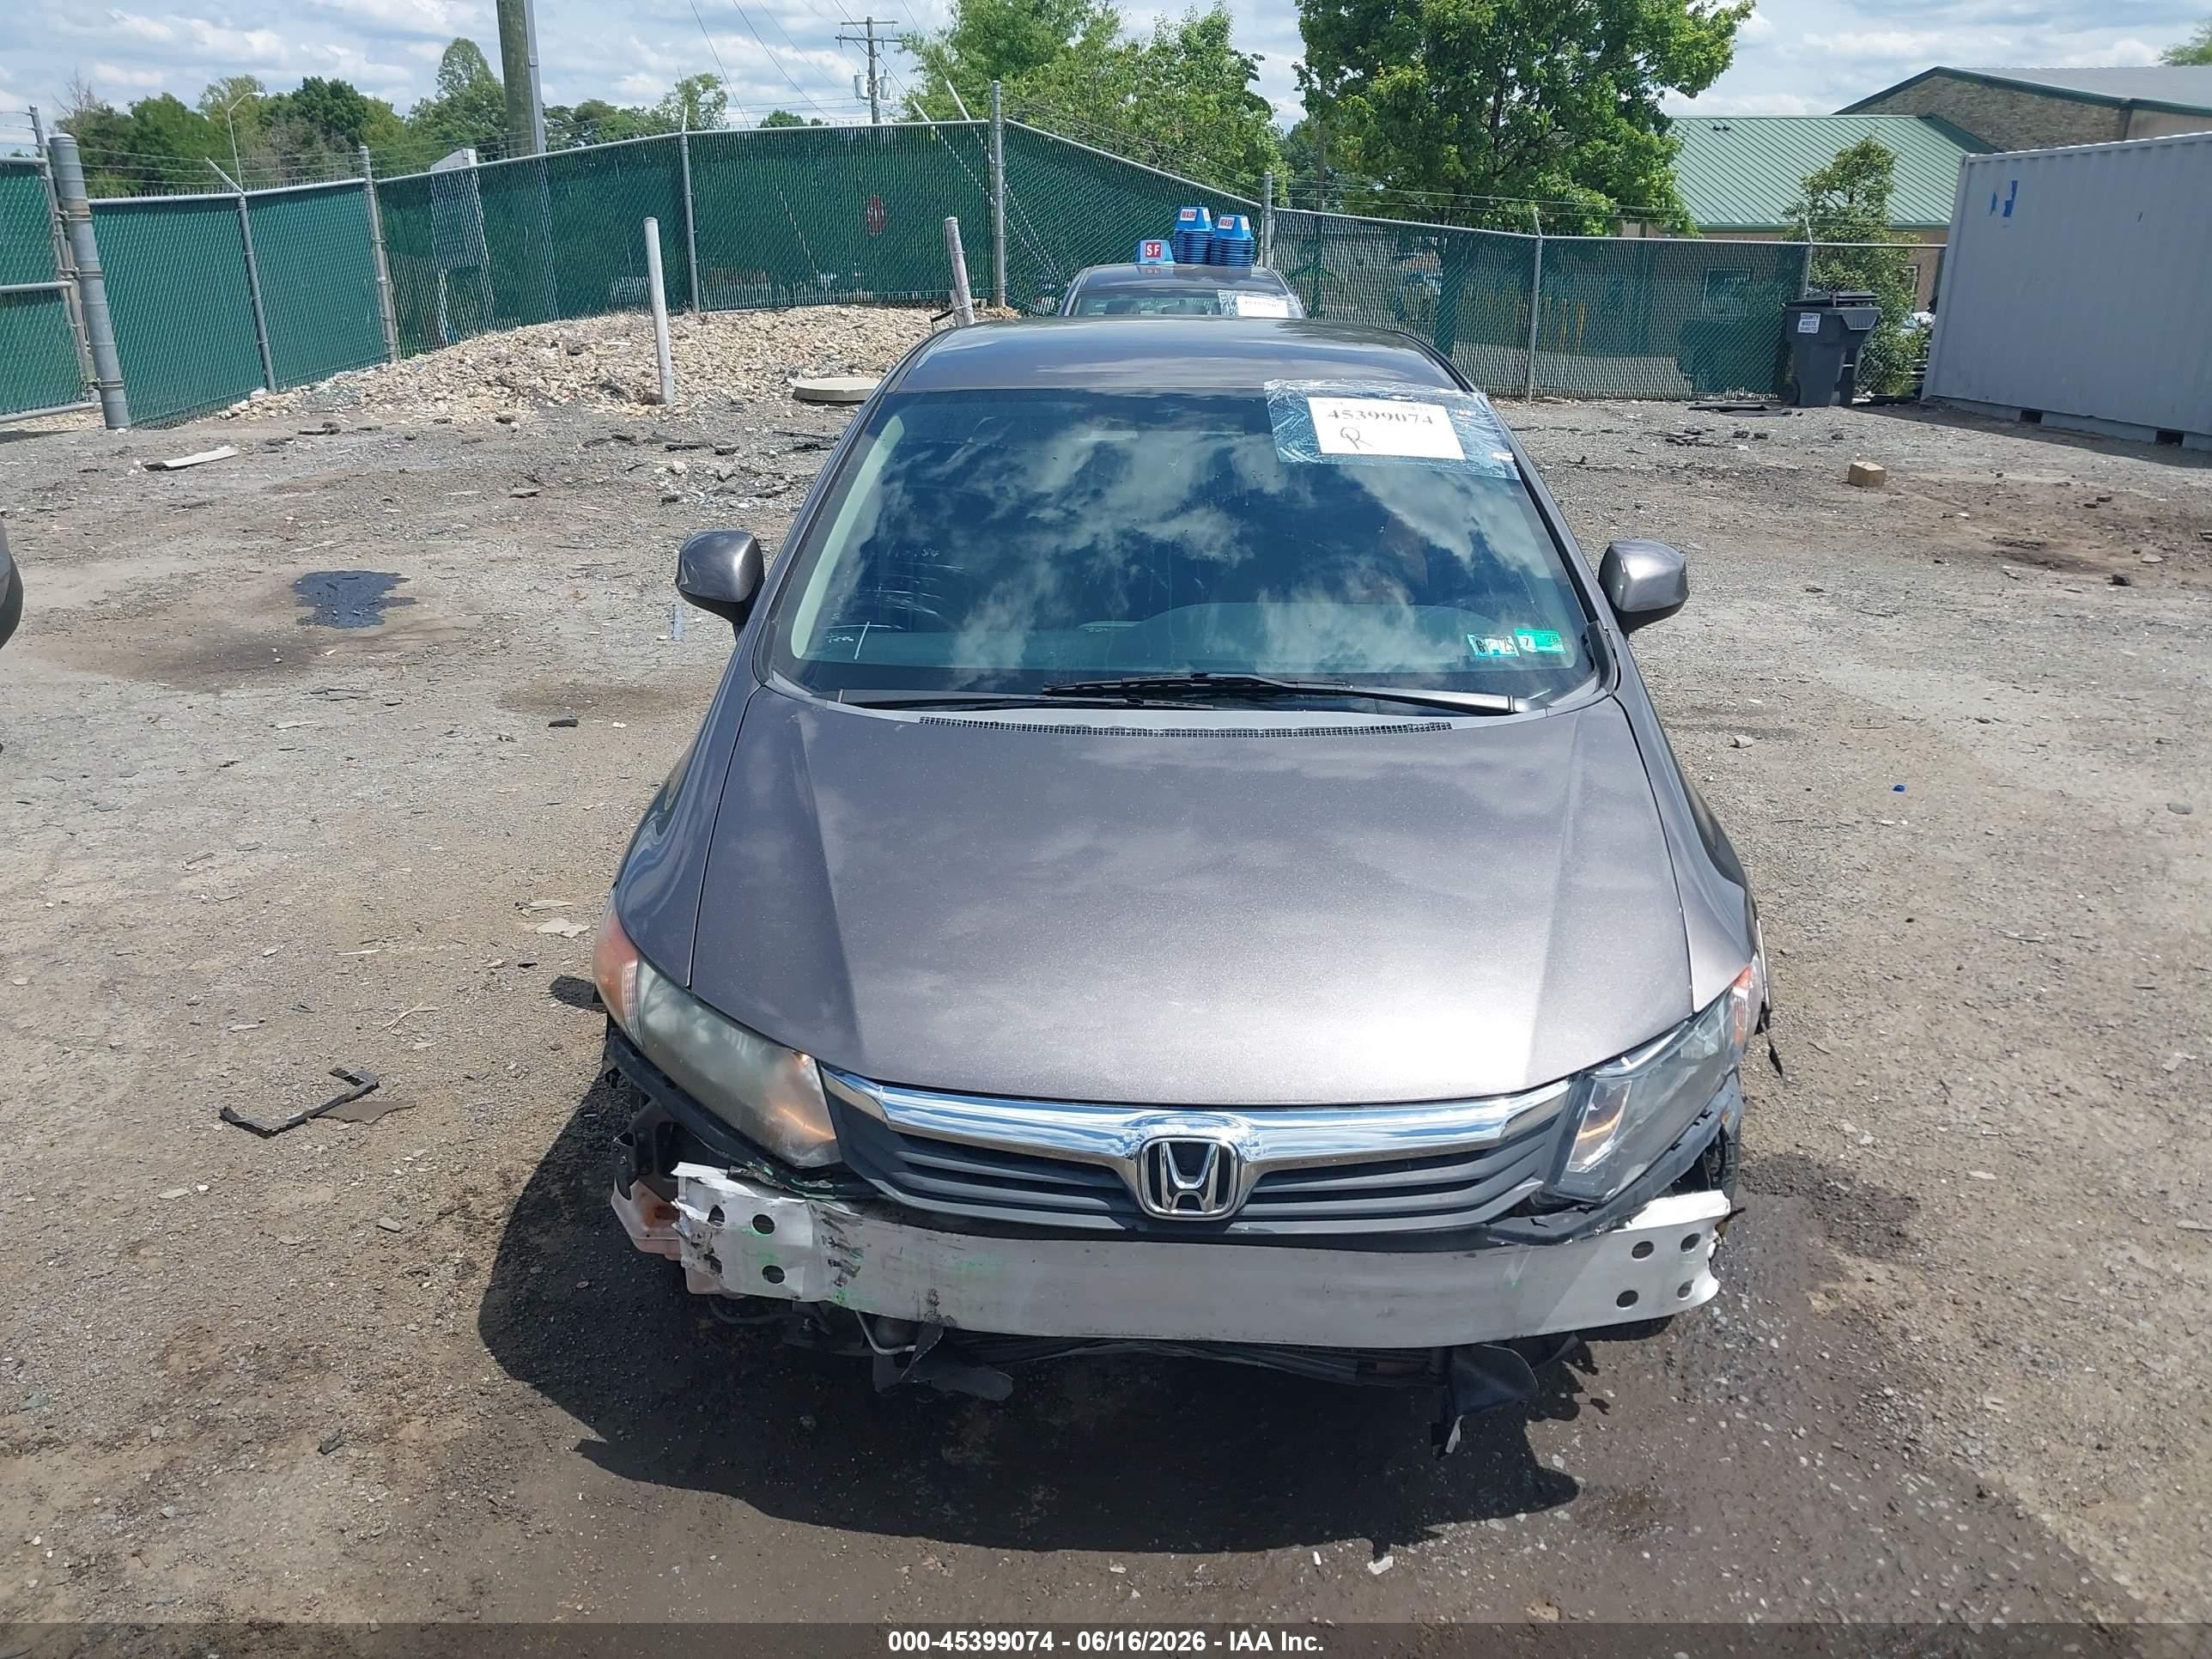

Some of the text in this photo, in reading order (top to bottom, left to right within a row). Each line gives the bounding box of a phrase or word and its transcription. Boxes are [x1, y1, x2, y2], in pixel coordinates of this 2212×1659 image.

[1182, 210, 1196, 219] WASH
[1219, 218, 1234, 228] WASH
[1326, 409, 1433, 424] 45399074
[1522, 637, 1529, 647] 7
